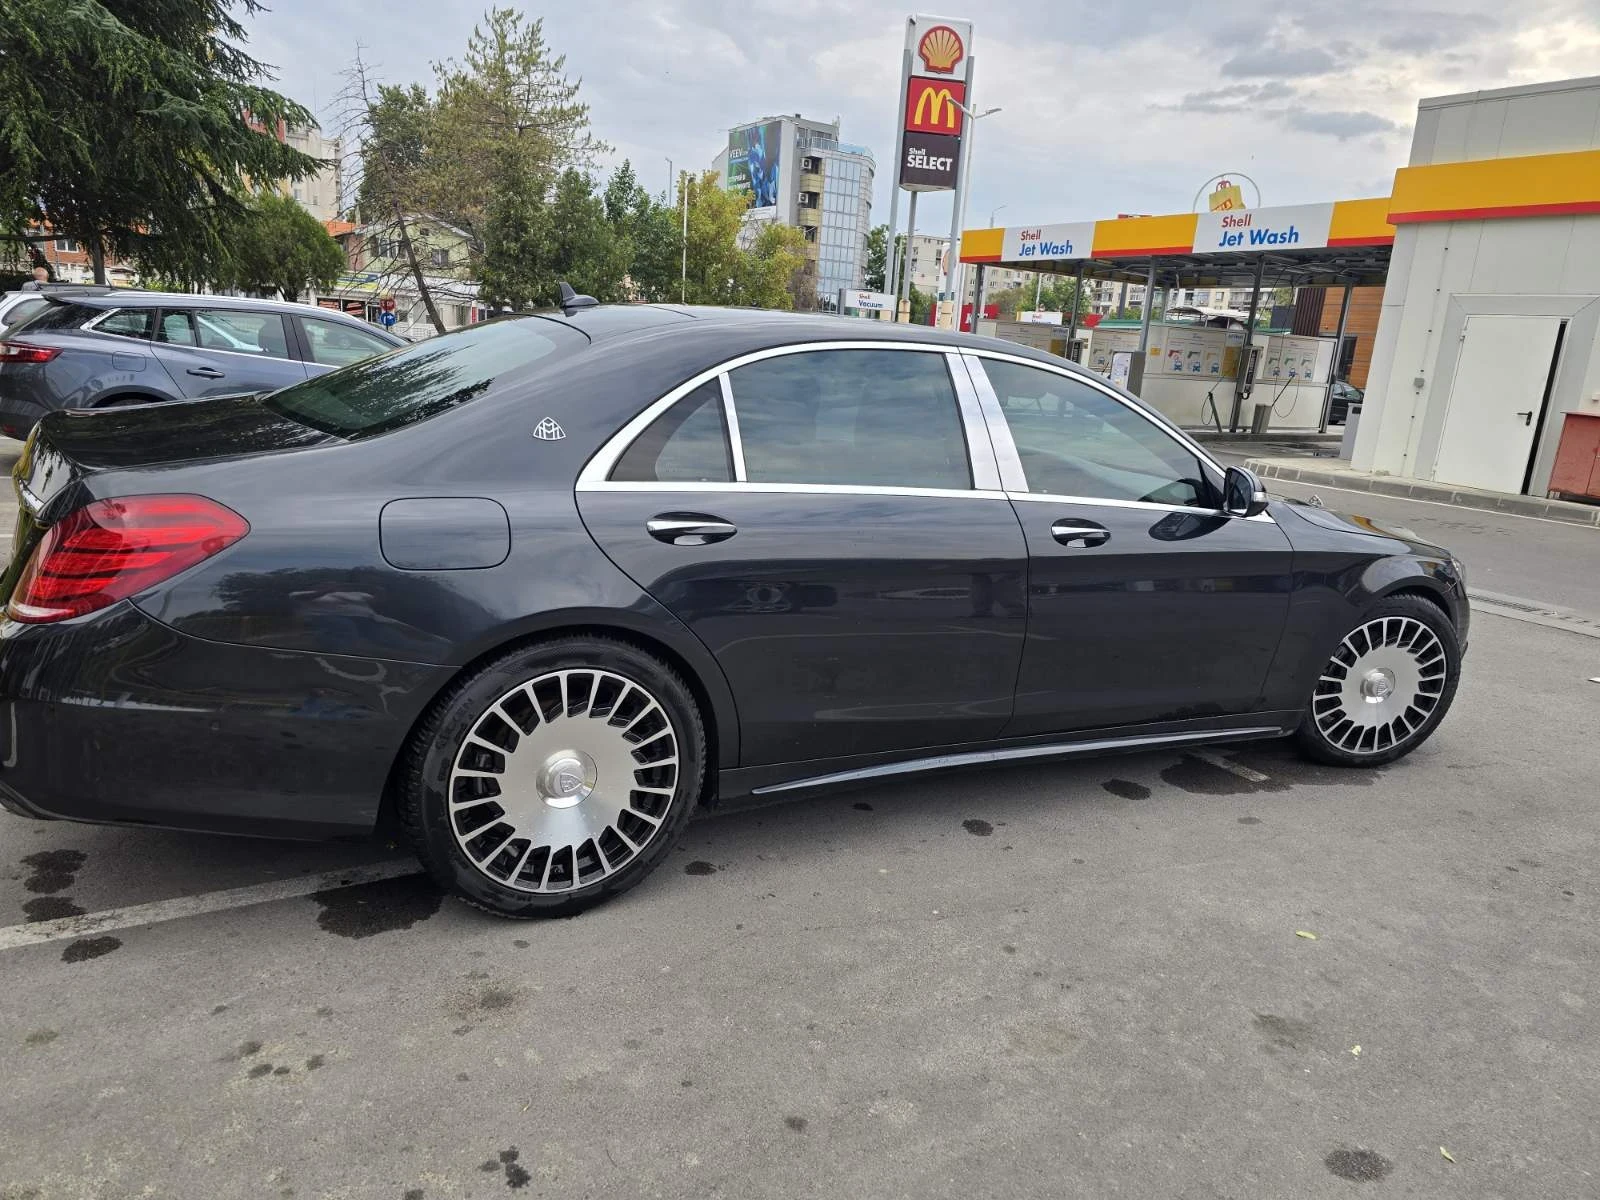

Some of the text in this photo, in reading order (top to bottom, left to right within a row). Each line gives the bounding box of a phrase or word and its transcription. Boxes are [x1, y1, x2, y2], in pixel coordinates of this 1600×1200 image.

[908, 147, 926, 155] Shell
[907, 155, 953, 171] SELECT
[1221, 213, 1252, 228] Shell
[1020, 229, 1041, 240] Shell
[1219, 225, 1299, 247] Jet Wash
[1019, 240, 1073, 256] Jet Wash
[858, 300, 884, 308] Vacuum
